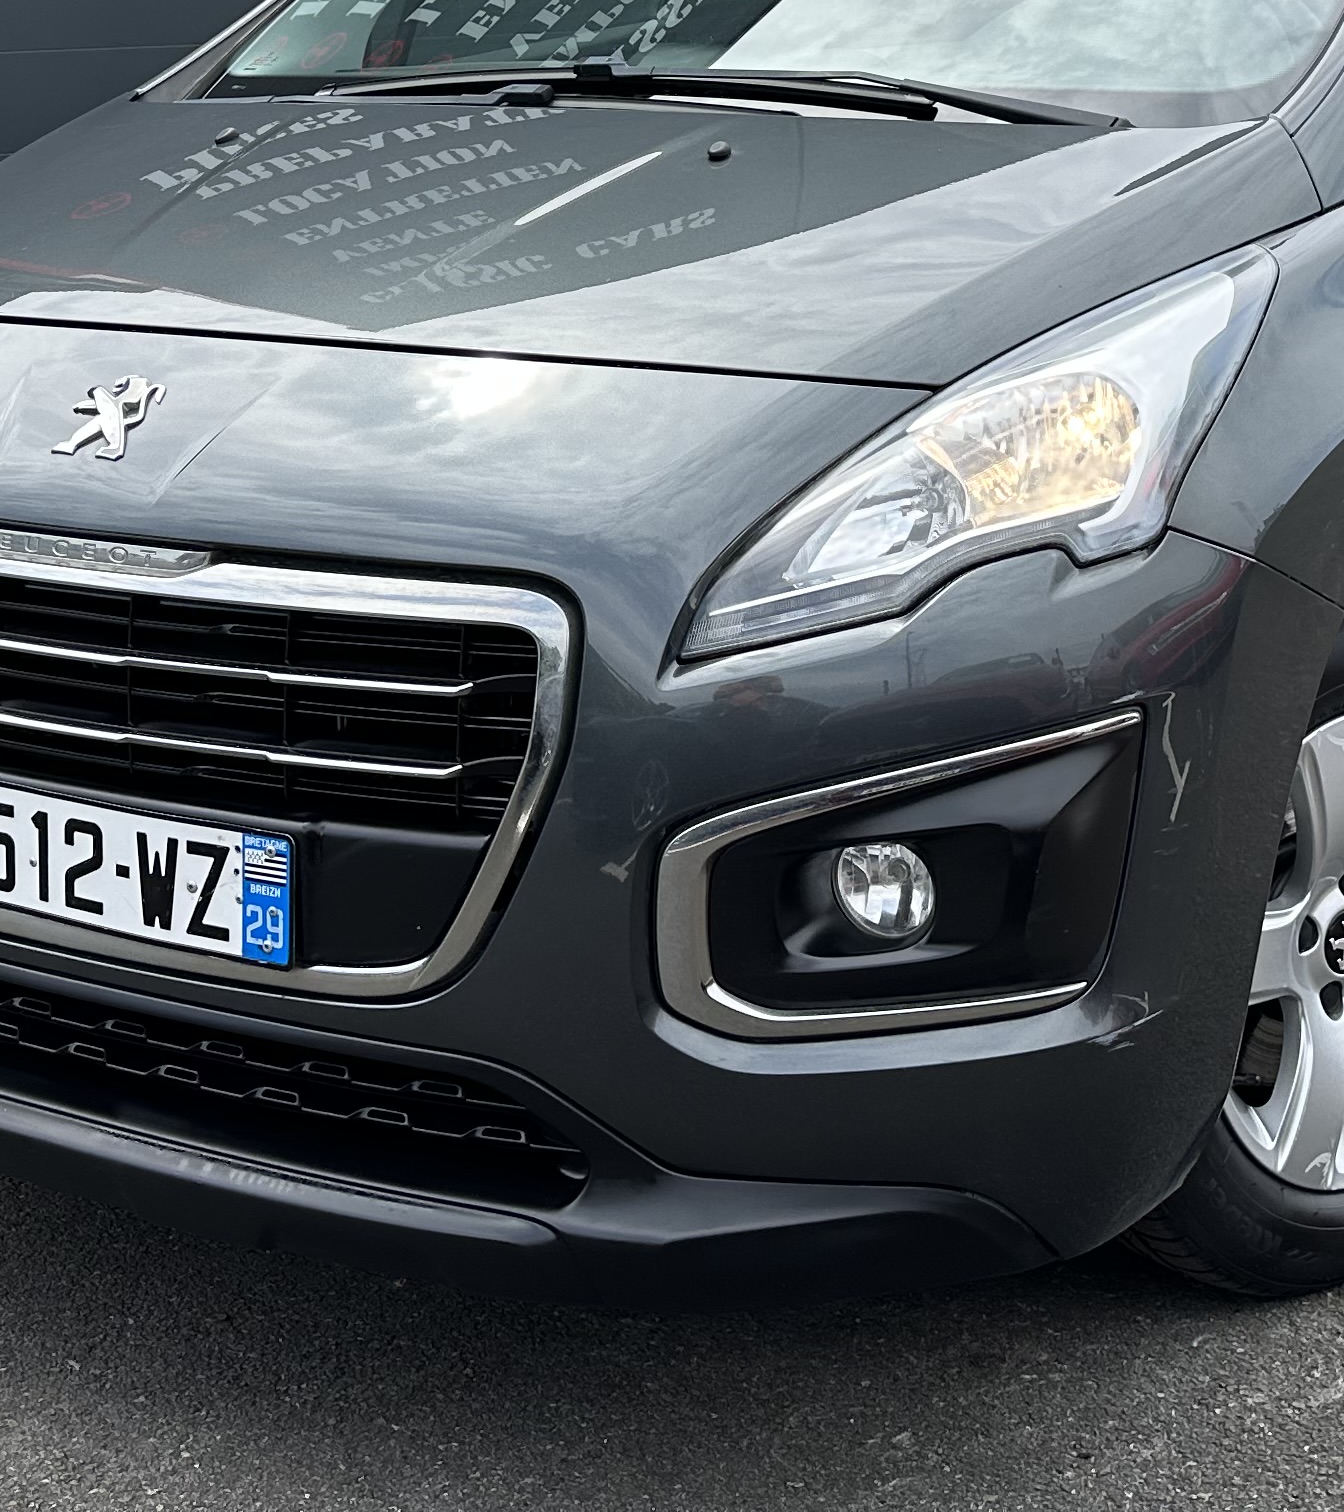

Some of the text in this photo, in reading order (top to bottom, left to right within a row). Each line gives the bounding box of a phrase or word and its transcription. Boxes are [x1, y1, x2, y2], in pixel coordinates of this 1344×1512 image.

[244, 835, 288, 852] BRETAGNE
[249, 883, 281, 899] BREIZH
[245, 903, 284, 950] 29
